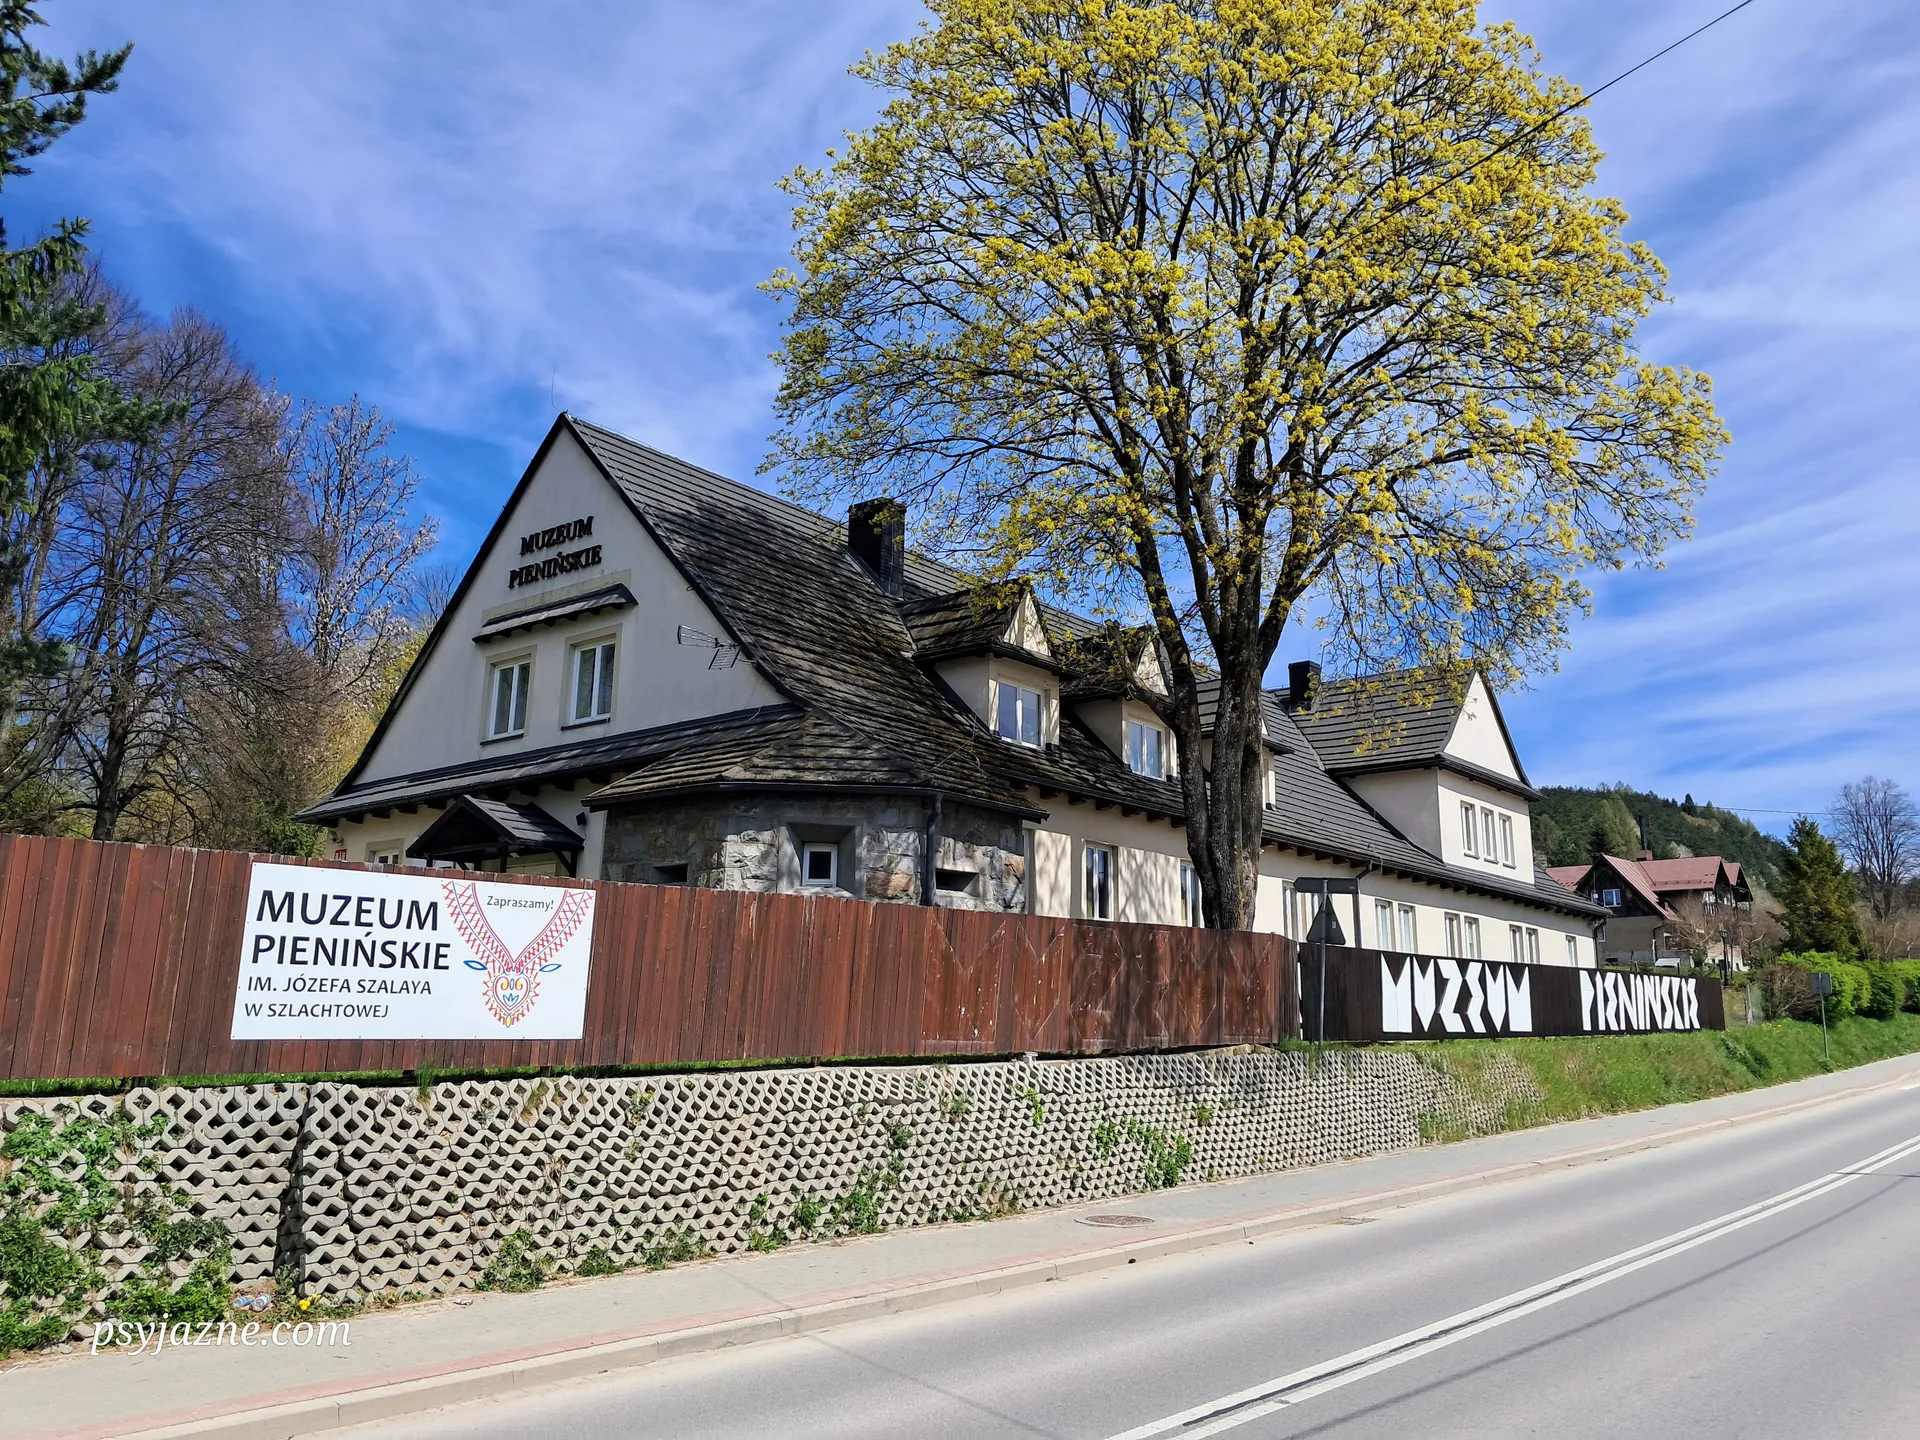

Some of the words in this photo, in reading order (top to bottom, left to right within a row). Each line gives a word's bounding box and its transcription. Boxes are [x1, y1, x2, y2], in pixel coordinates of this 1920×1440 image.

[520, 516, 594, 556] MUZEUM
[508, 545, 602, 588] PIENIŃSKIE
[256, 890, 438, 931] MUZEUM
[487, 895, 554, 912] Zapraszamy!
[252, 931, 451, 970] PIENIŃSKIE
[247, 976, 277, 992] IM.
[283, 973, 351, 993] JÓZEFA
[356, 979, 432, 995] SZALAYA
[1380, 952, 1532, 1033] MUZEUM
[244, 1003, 263, 1017] W
[267, 1003, 389, 1018] SZLACHTOWEJ
